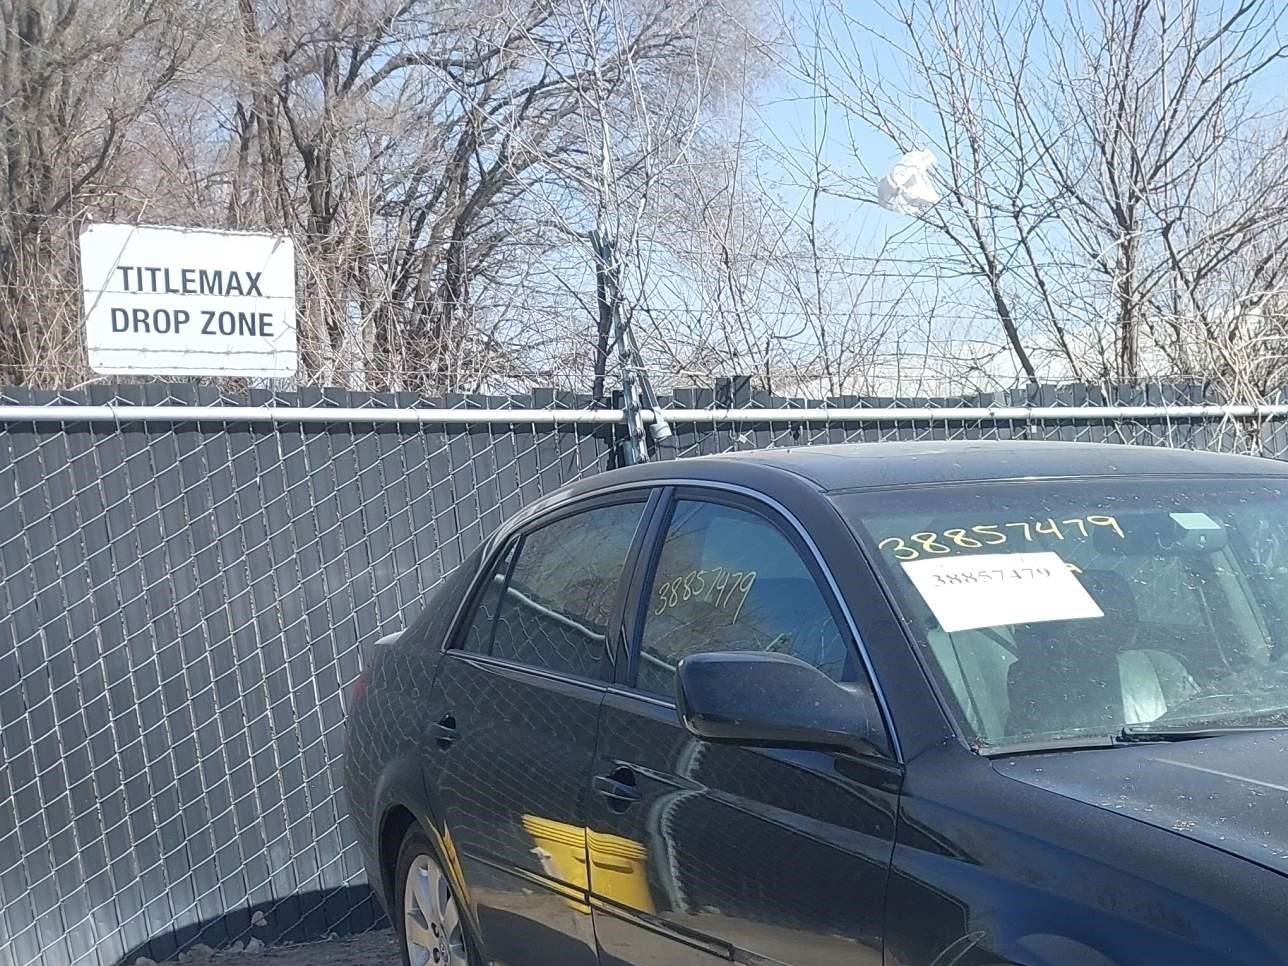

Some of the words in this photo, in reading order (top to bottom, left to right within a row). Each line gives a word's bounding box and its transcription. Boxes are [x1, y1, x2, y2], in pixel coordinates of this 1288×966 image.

[117, 266, 263, 297] TITLEMAX
[111, 307, 190, 334] DROP
[200, 310, 275, 337] ZONE
[879, 515, 1125, 560] 38857479
[932, 567, 1051, 588] 38857479
[655, 567, 757, 624] 38857479
